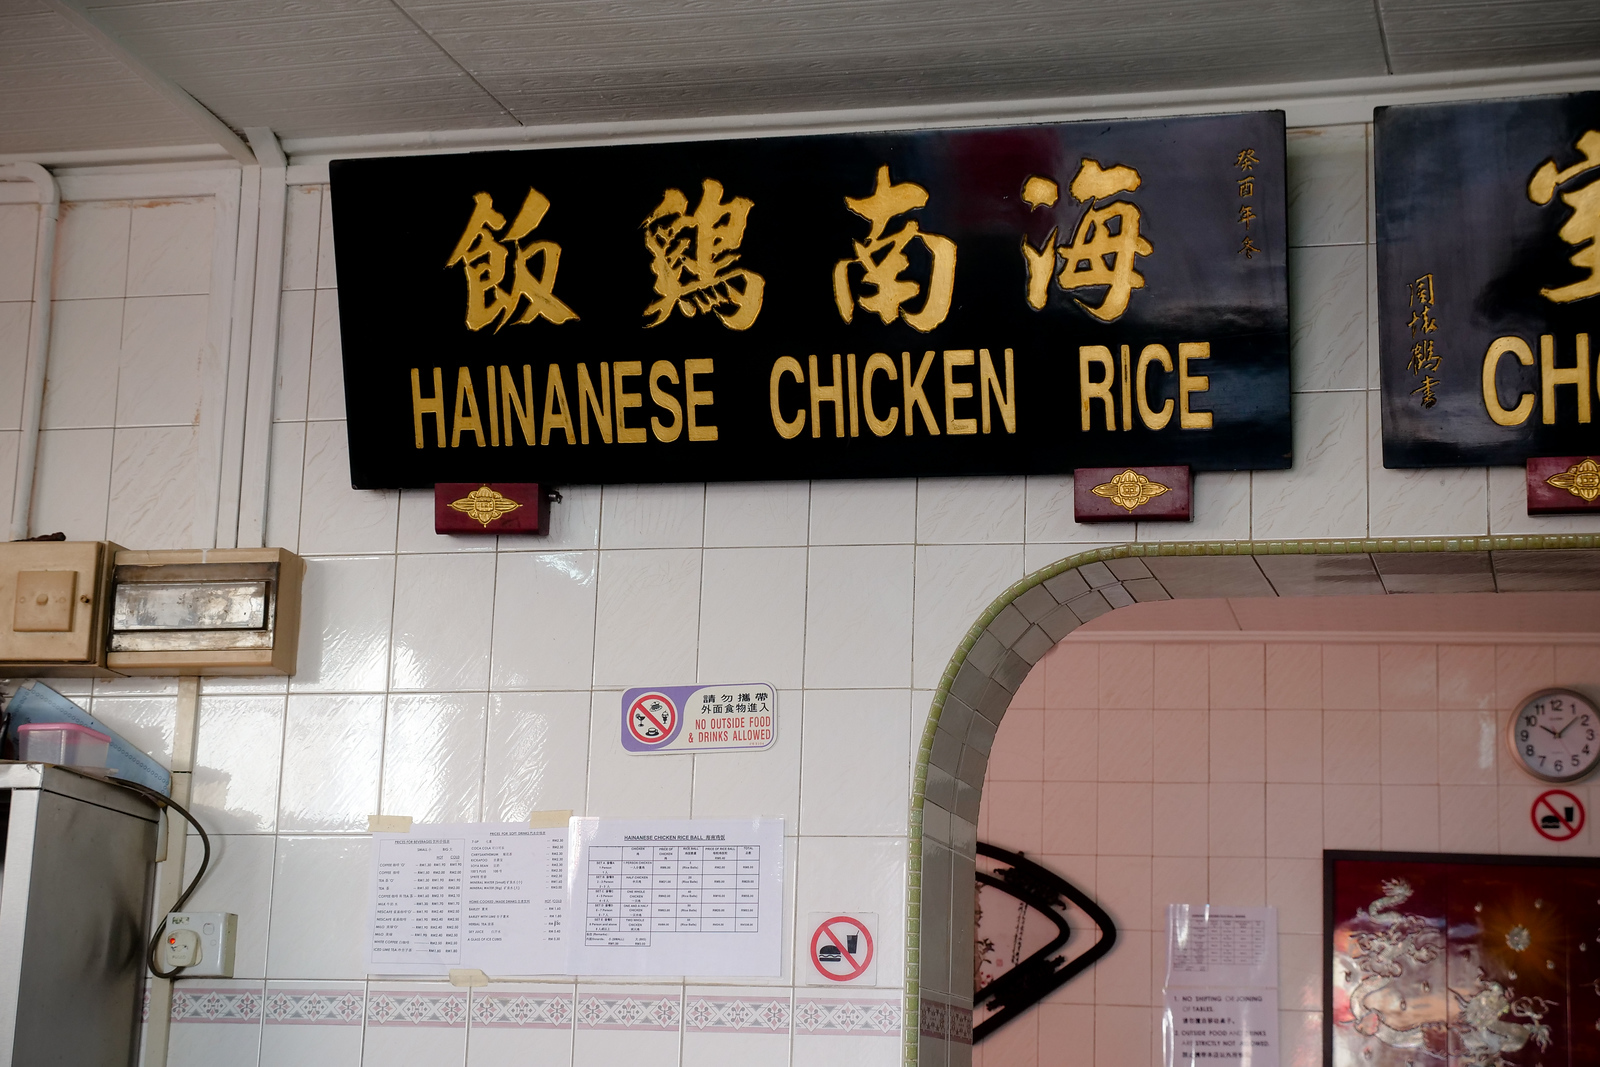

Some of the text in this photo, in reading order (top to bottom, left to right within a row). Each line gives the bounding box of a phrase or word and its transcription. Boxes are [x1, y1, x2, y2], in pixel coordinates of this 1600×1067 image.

[1482, 333, 1600, 425] CH
[411, 342, 1213, 448] HAINANESE CHICKEN RICE
[701, 703, 769, 714] 外面食物進入
[1535, 705, 1545, 715] 11
[1550, 700, 1562, 711] 12
[1571, 704, 1576, 714] 1
[696, 716, 771, 730] NO OUTSIDE FOOD
[1525, 716, 1537, 726] 10
[1581, 715, 1589, 726] 2
[688, 729, 771, 743] & DRINKS ALLOWED
[1521, 730, 1529, 741] 9
[1586, 729, 1594, 740] 3
[1526, 745, 1534, 756] 8
[1582, 745, 1589, 755] 4
[1539, 756, 1546, 766] 7
[1554, 760, 1563, 772] 6
[1572, 755, 1580, 766] 5
